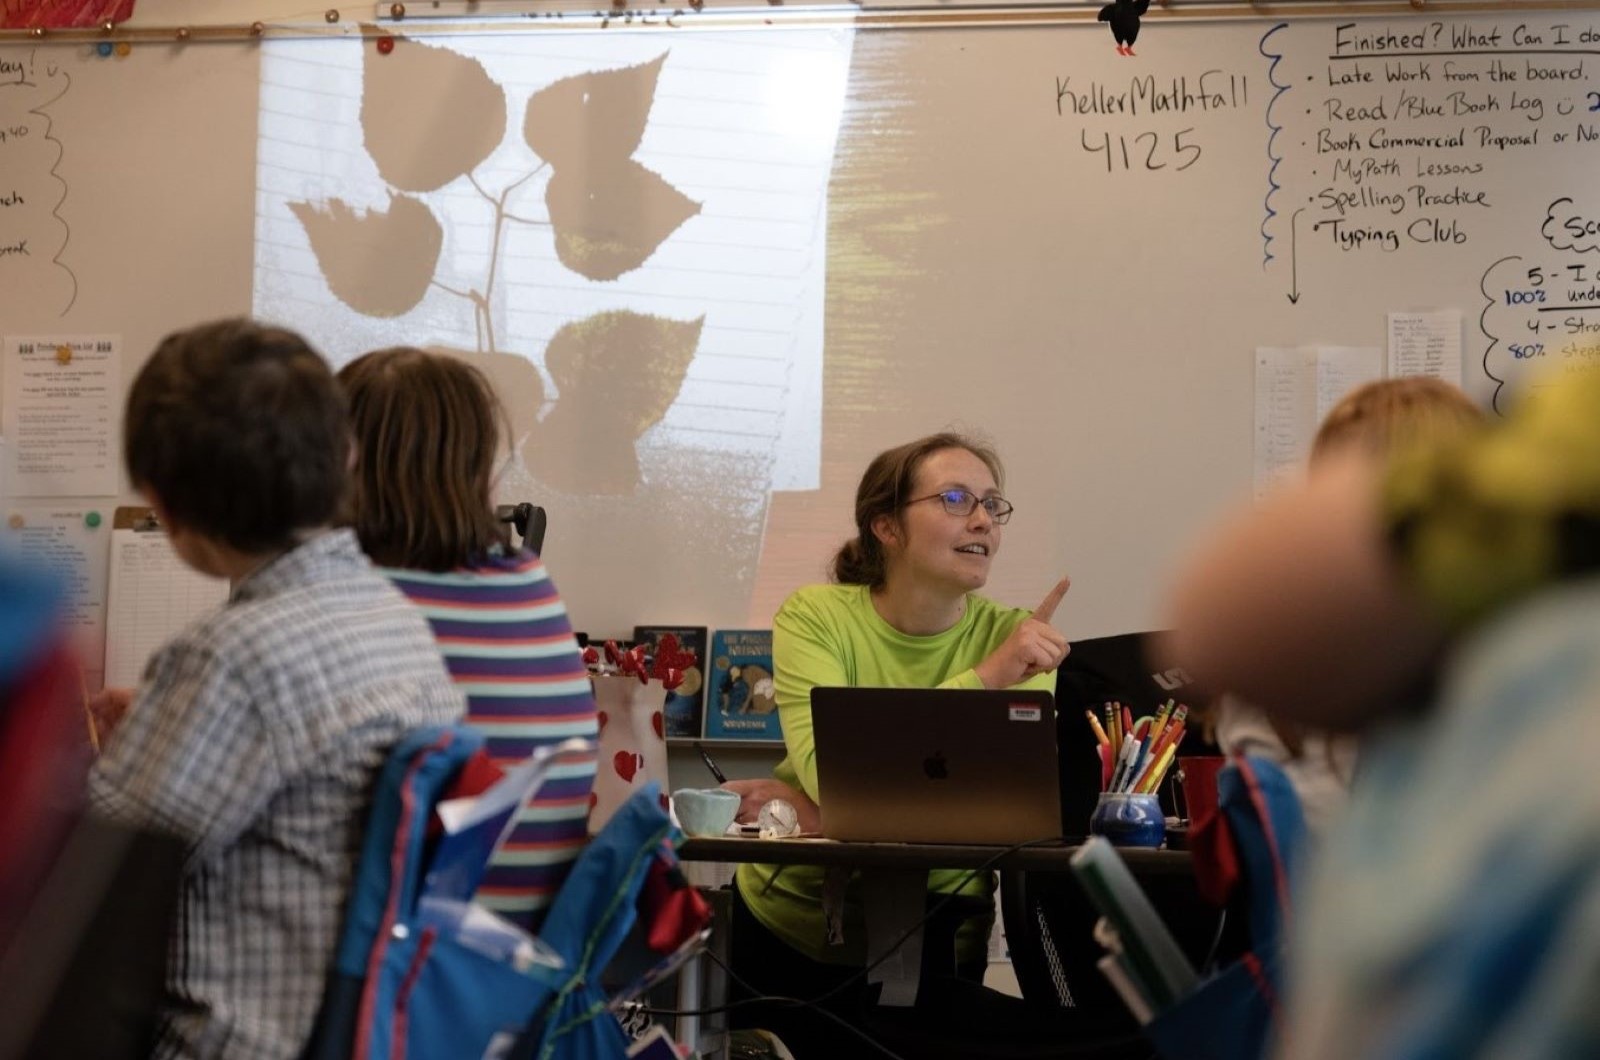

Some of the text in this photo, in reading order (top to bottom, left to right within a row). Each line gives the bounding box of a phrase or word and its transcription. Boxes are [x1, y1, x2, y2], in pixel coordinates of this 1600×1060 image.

[1336, 22, 1443, 54] Finished?
[1450, 24, 1502, 48] What
[1512, 24, 1544, 46] Can
[1549, 24, 1571, 45] I
[0, 49, 36, 84] ay!
[1327, 58, 1590, 86] Late Work from the board.
[1447, 91, 1500, 117] Book
[1510, 96, 1544, 121] Log
[1080, 127, 1202, 173] 4125
[1316, 128, 1361, 155] Book
[1368, 128, 1465, 150] Commercial
[1473, 126, 1538, 150] Proposal
[1552, 132, 1570, 143] or
[1416, 156, 1483, 178] Lessons
[1317, 185, 1492, 213] Spelling Practice
[1321, 217, 1467, 250] Typing Club
[1527, 267, 1544, 286] 5
[1566, 264, 1587, 282] I
[1527, 319, 1540, 334] 4
